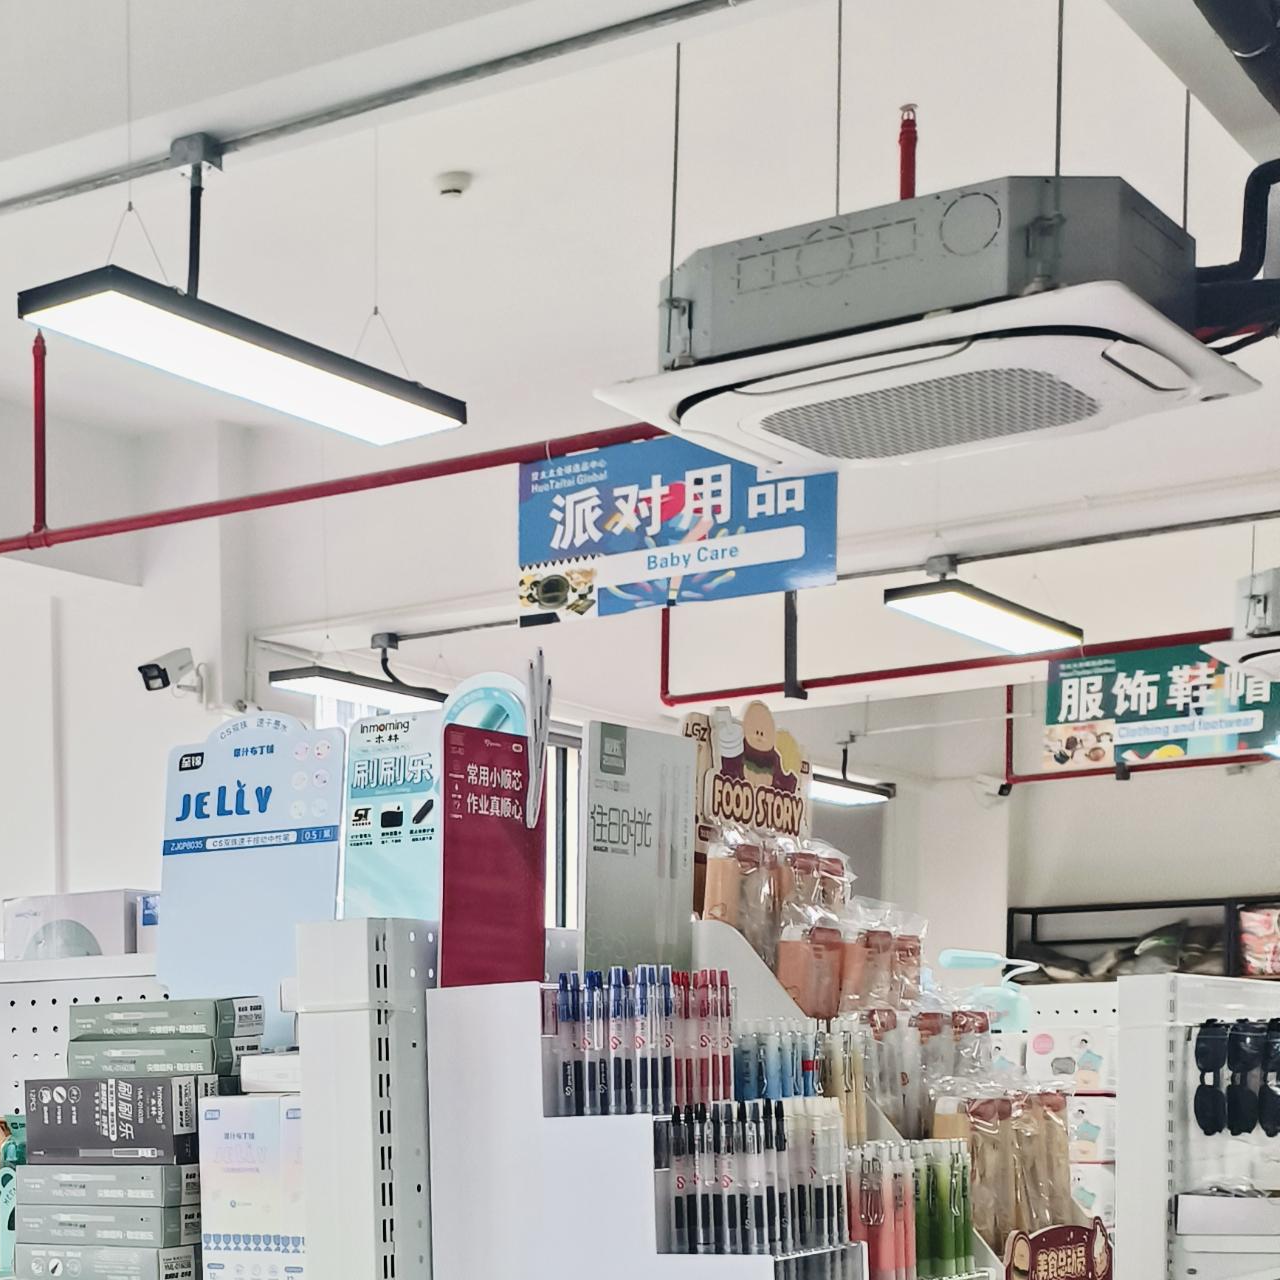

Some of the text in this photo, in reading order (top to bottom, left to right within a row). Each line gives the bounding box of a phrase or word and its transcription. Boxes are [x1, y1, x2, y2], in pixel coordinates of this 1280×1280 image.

[531, 471, 608, 494] HuoTaitai Global
[549, 463, 805, 551] 派对用品
[647, 546, 740, 571] Baby Care
[1057, 661, 1270, 723] 服饰鞋帽
[684, 722, 708, 742] LGZ
[1173, 719, 1196, 734] and
[352, 752, 434, 789] 刷刷乐
[466, 763, 523, 791] 常用小顺芯
[175, 780, 272, 822] JELLY
[466, 793, 523, 821] 作业真顺心
[712, 774, 804, 837] FOOD STORY
[304, 831, 318, 840] 0.5
[118, 1080, 135, 1140] 刷刷乐
